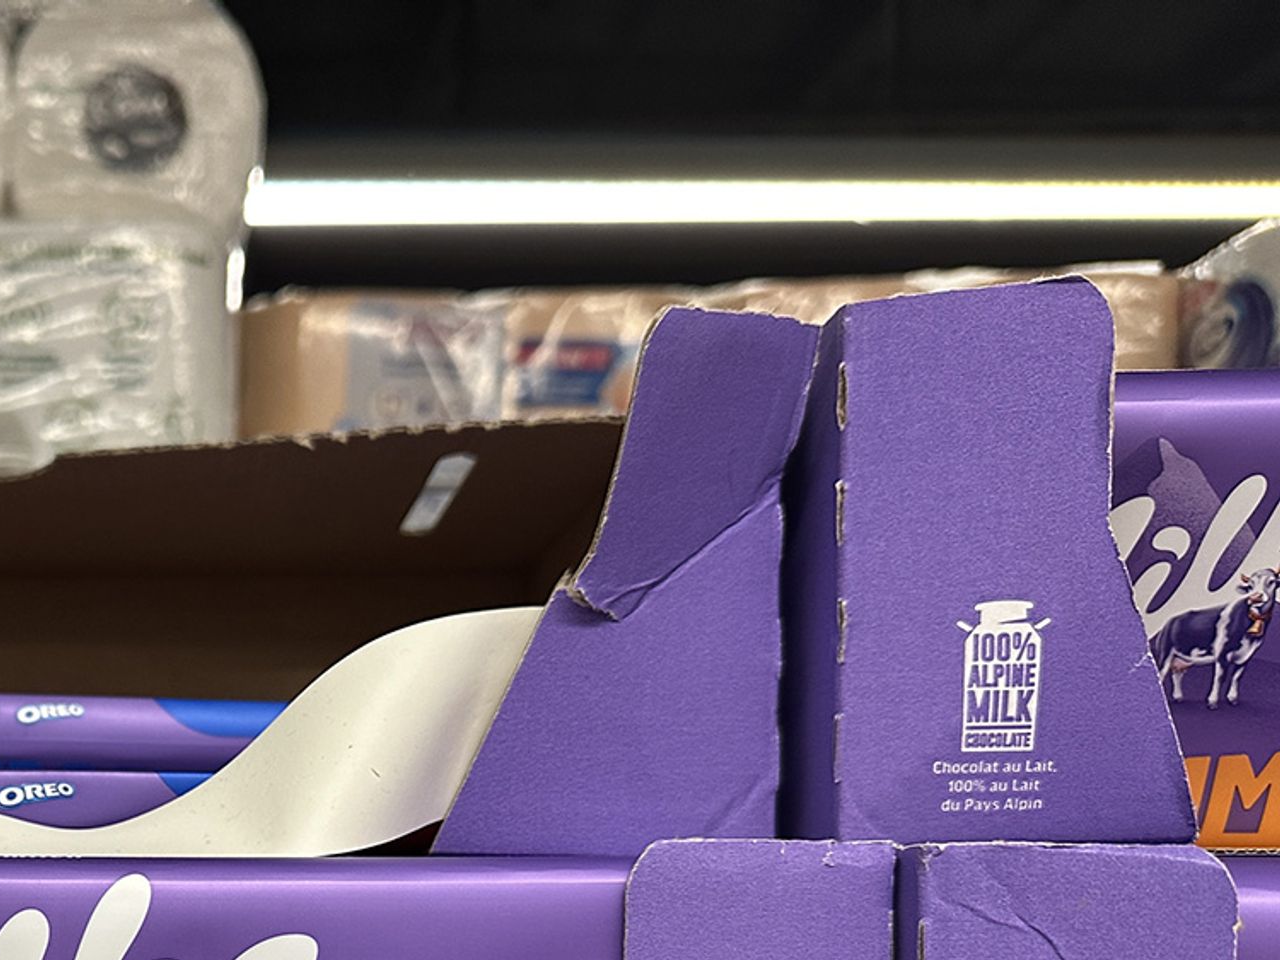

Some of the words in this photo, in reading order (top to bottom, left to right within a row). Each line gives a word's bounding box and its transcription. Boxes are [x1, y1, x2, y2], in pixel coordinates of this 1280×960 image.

[972, 632, 1036, 662] 100%
[968, 663, 1037, 688] ALPINE
[17, 703, 85, 724] OREO
[966, 689, 1035, 722] MILK
[964, 732, 1031, 748] CHOCOLATE
[932, 760, 998, 774] Chocolat
[1002, 762, 1021, 773] au
[947, 779, 985, 792] 100%
[989, 781, 1008, 792] au
[1011, 779, 1040, 791] Lait
[941, 799, 960, 811] du
[964, 798, 999, 811] Pays
[1003, 797, 1043, 810] Alpin
